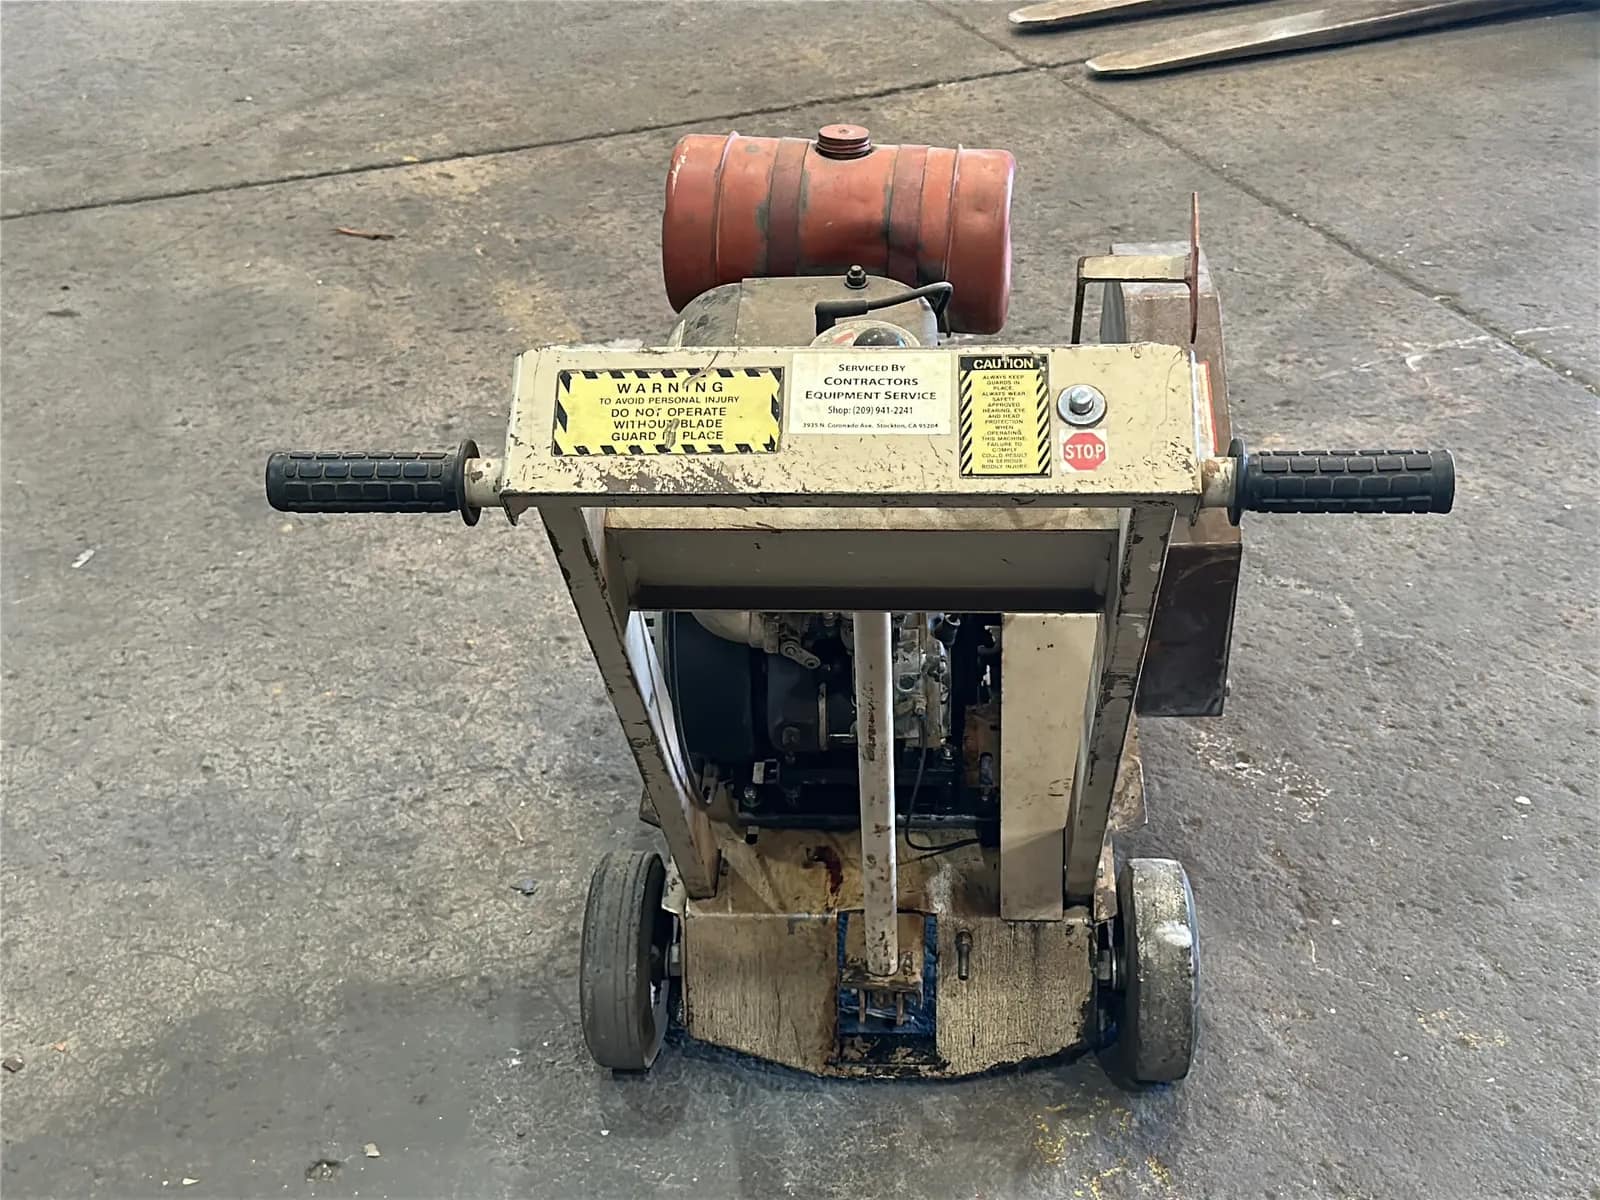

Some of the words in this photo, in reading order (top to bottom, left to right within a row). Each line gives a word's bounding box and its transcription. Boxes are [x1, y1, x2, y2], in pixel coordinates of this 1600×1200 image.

[974, 358, 1034, 369] CAUTION
[824, 377, 918, 386] CONTRACTORS
[617, 382, 723, 394] WARNING
[805, 390, 881, 400] EQUIPMENT
[884, 391, 936, 400] SERVICE
[612, 408, 628, 418] DO
[636, 408, 662, 417] NOT
[668, 407, 727, 416] OPERATE
[828, 406, 850, 416] Shop:
[852, 406, 874, 415] (209)
[680, 419, 722, 428] BLADE
[612, 432, 656, 441] GUARD
[682, 431, 723, 440] PLACE
[1065, 445, 1104, 460] STOP
